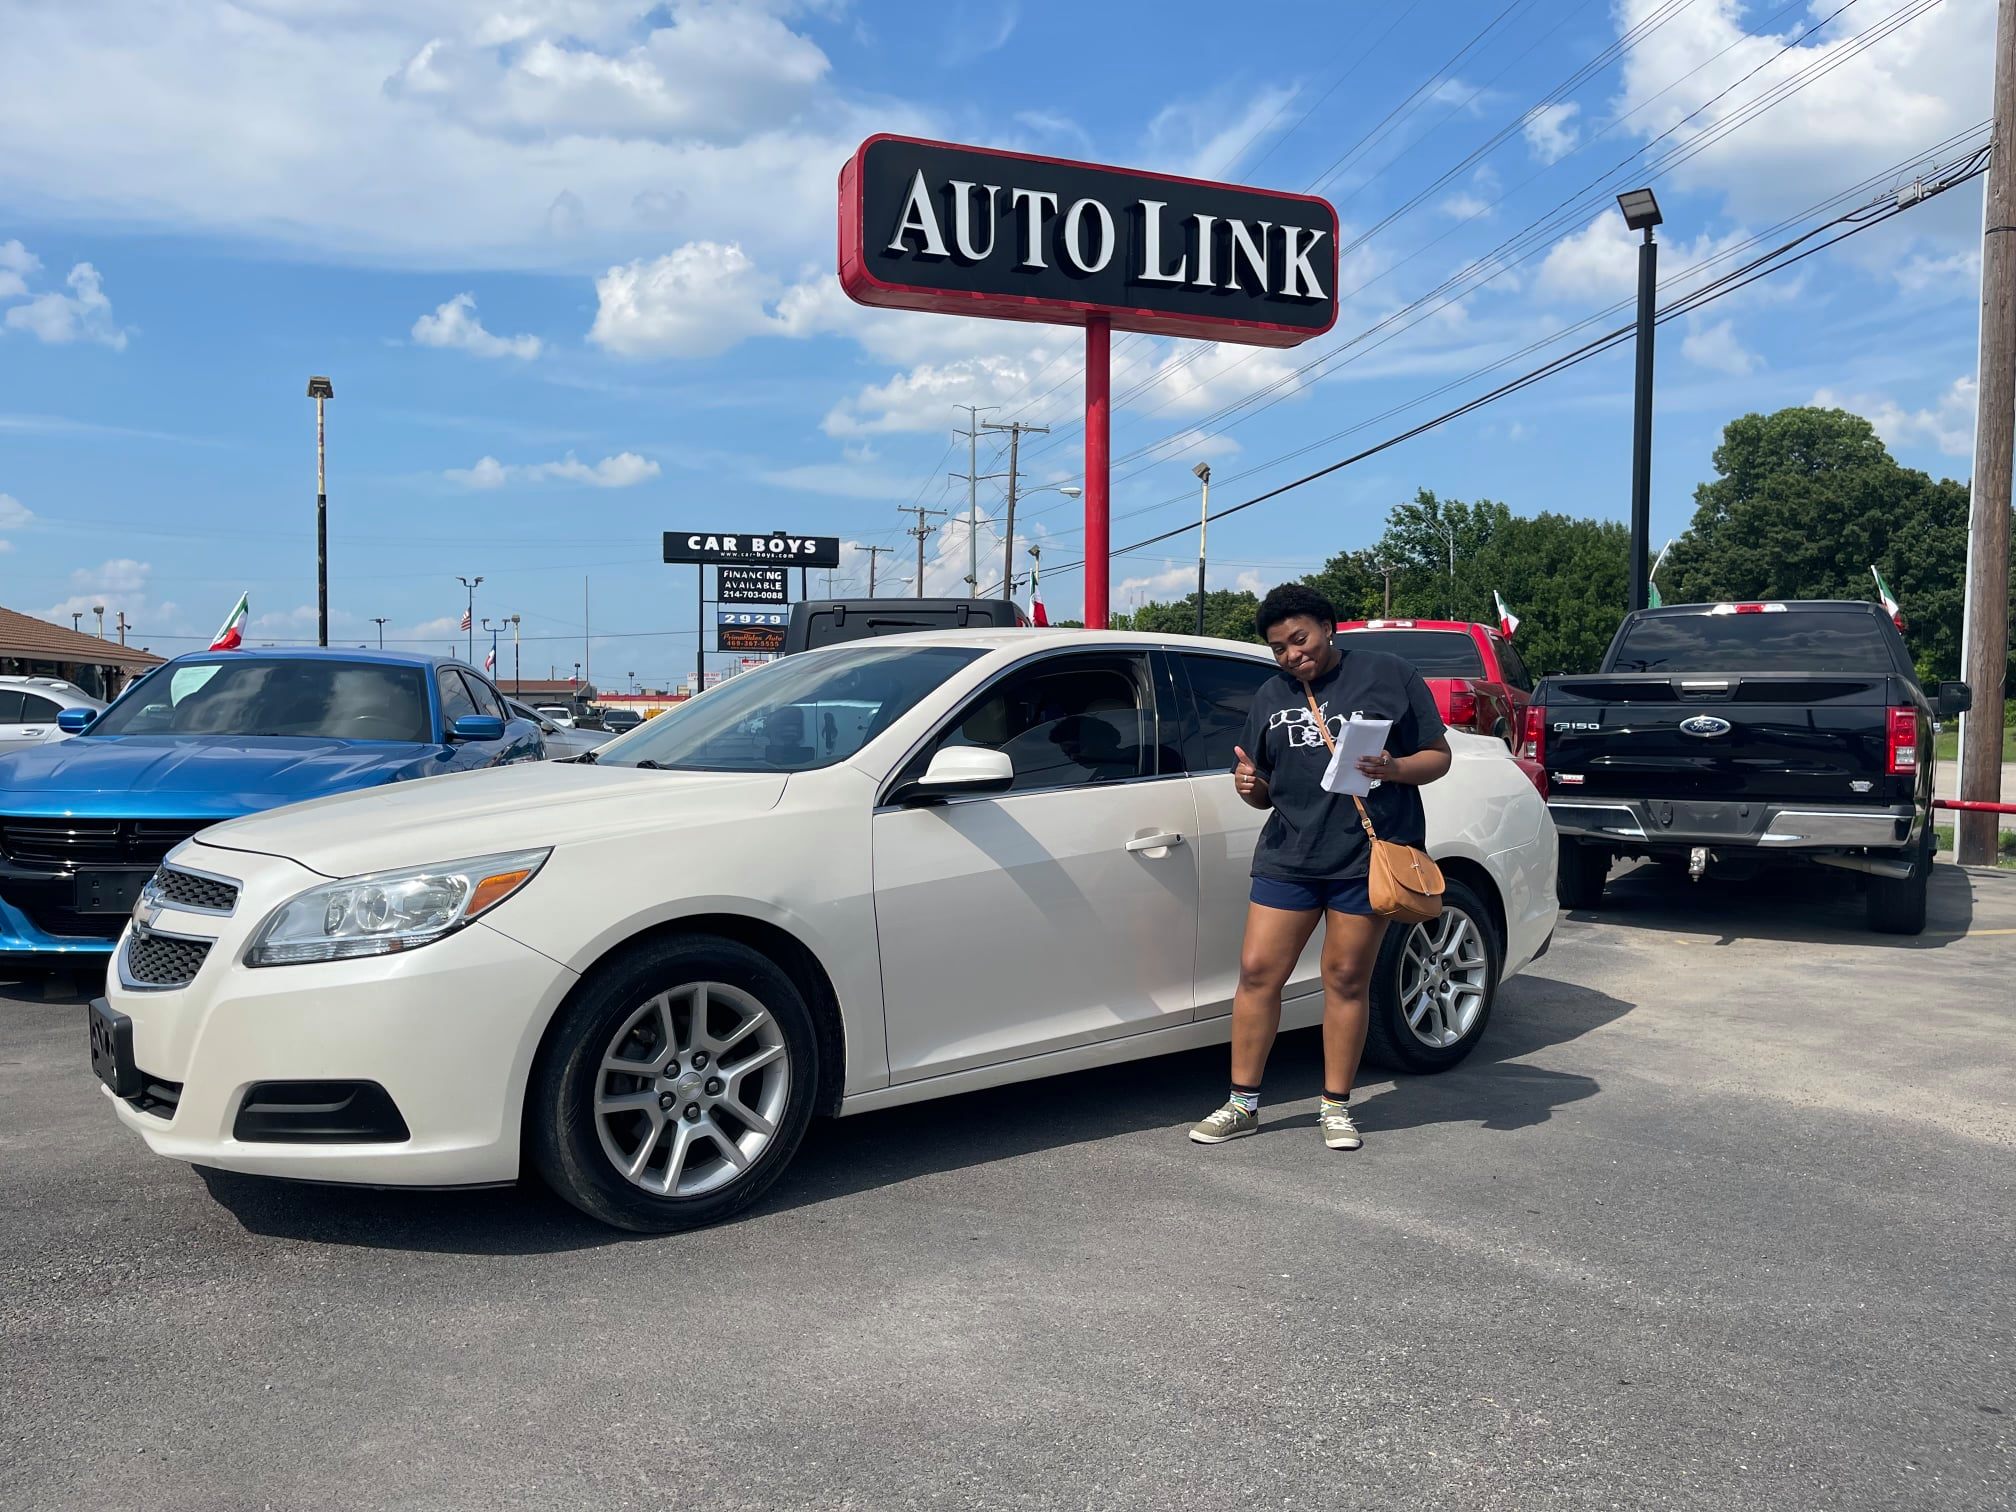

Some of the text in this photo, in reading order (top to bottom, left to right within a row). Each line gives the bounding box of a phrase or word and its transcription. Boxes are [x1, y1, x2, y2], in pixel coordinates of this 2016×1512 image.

[887, 168, 1329, 300] AUTO LINK
[687, 535, 817, 554] CAR BOYS
[723, 569, 782, 580] FINANCING
[724, 580, 782, 590] AVAILABLE
[723, 590, 783, 599] 214-703-0088
[724, 614, 781, 624] 2929
